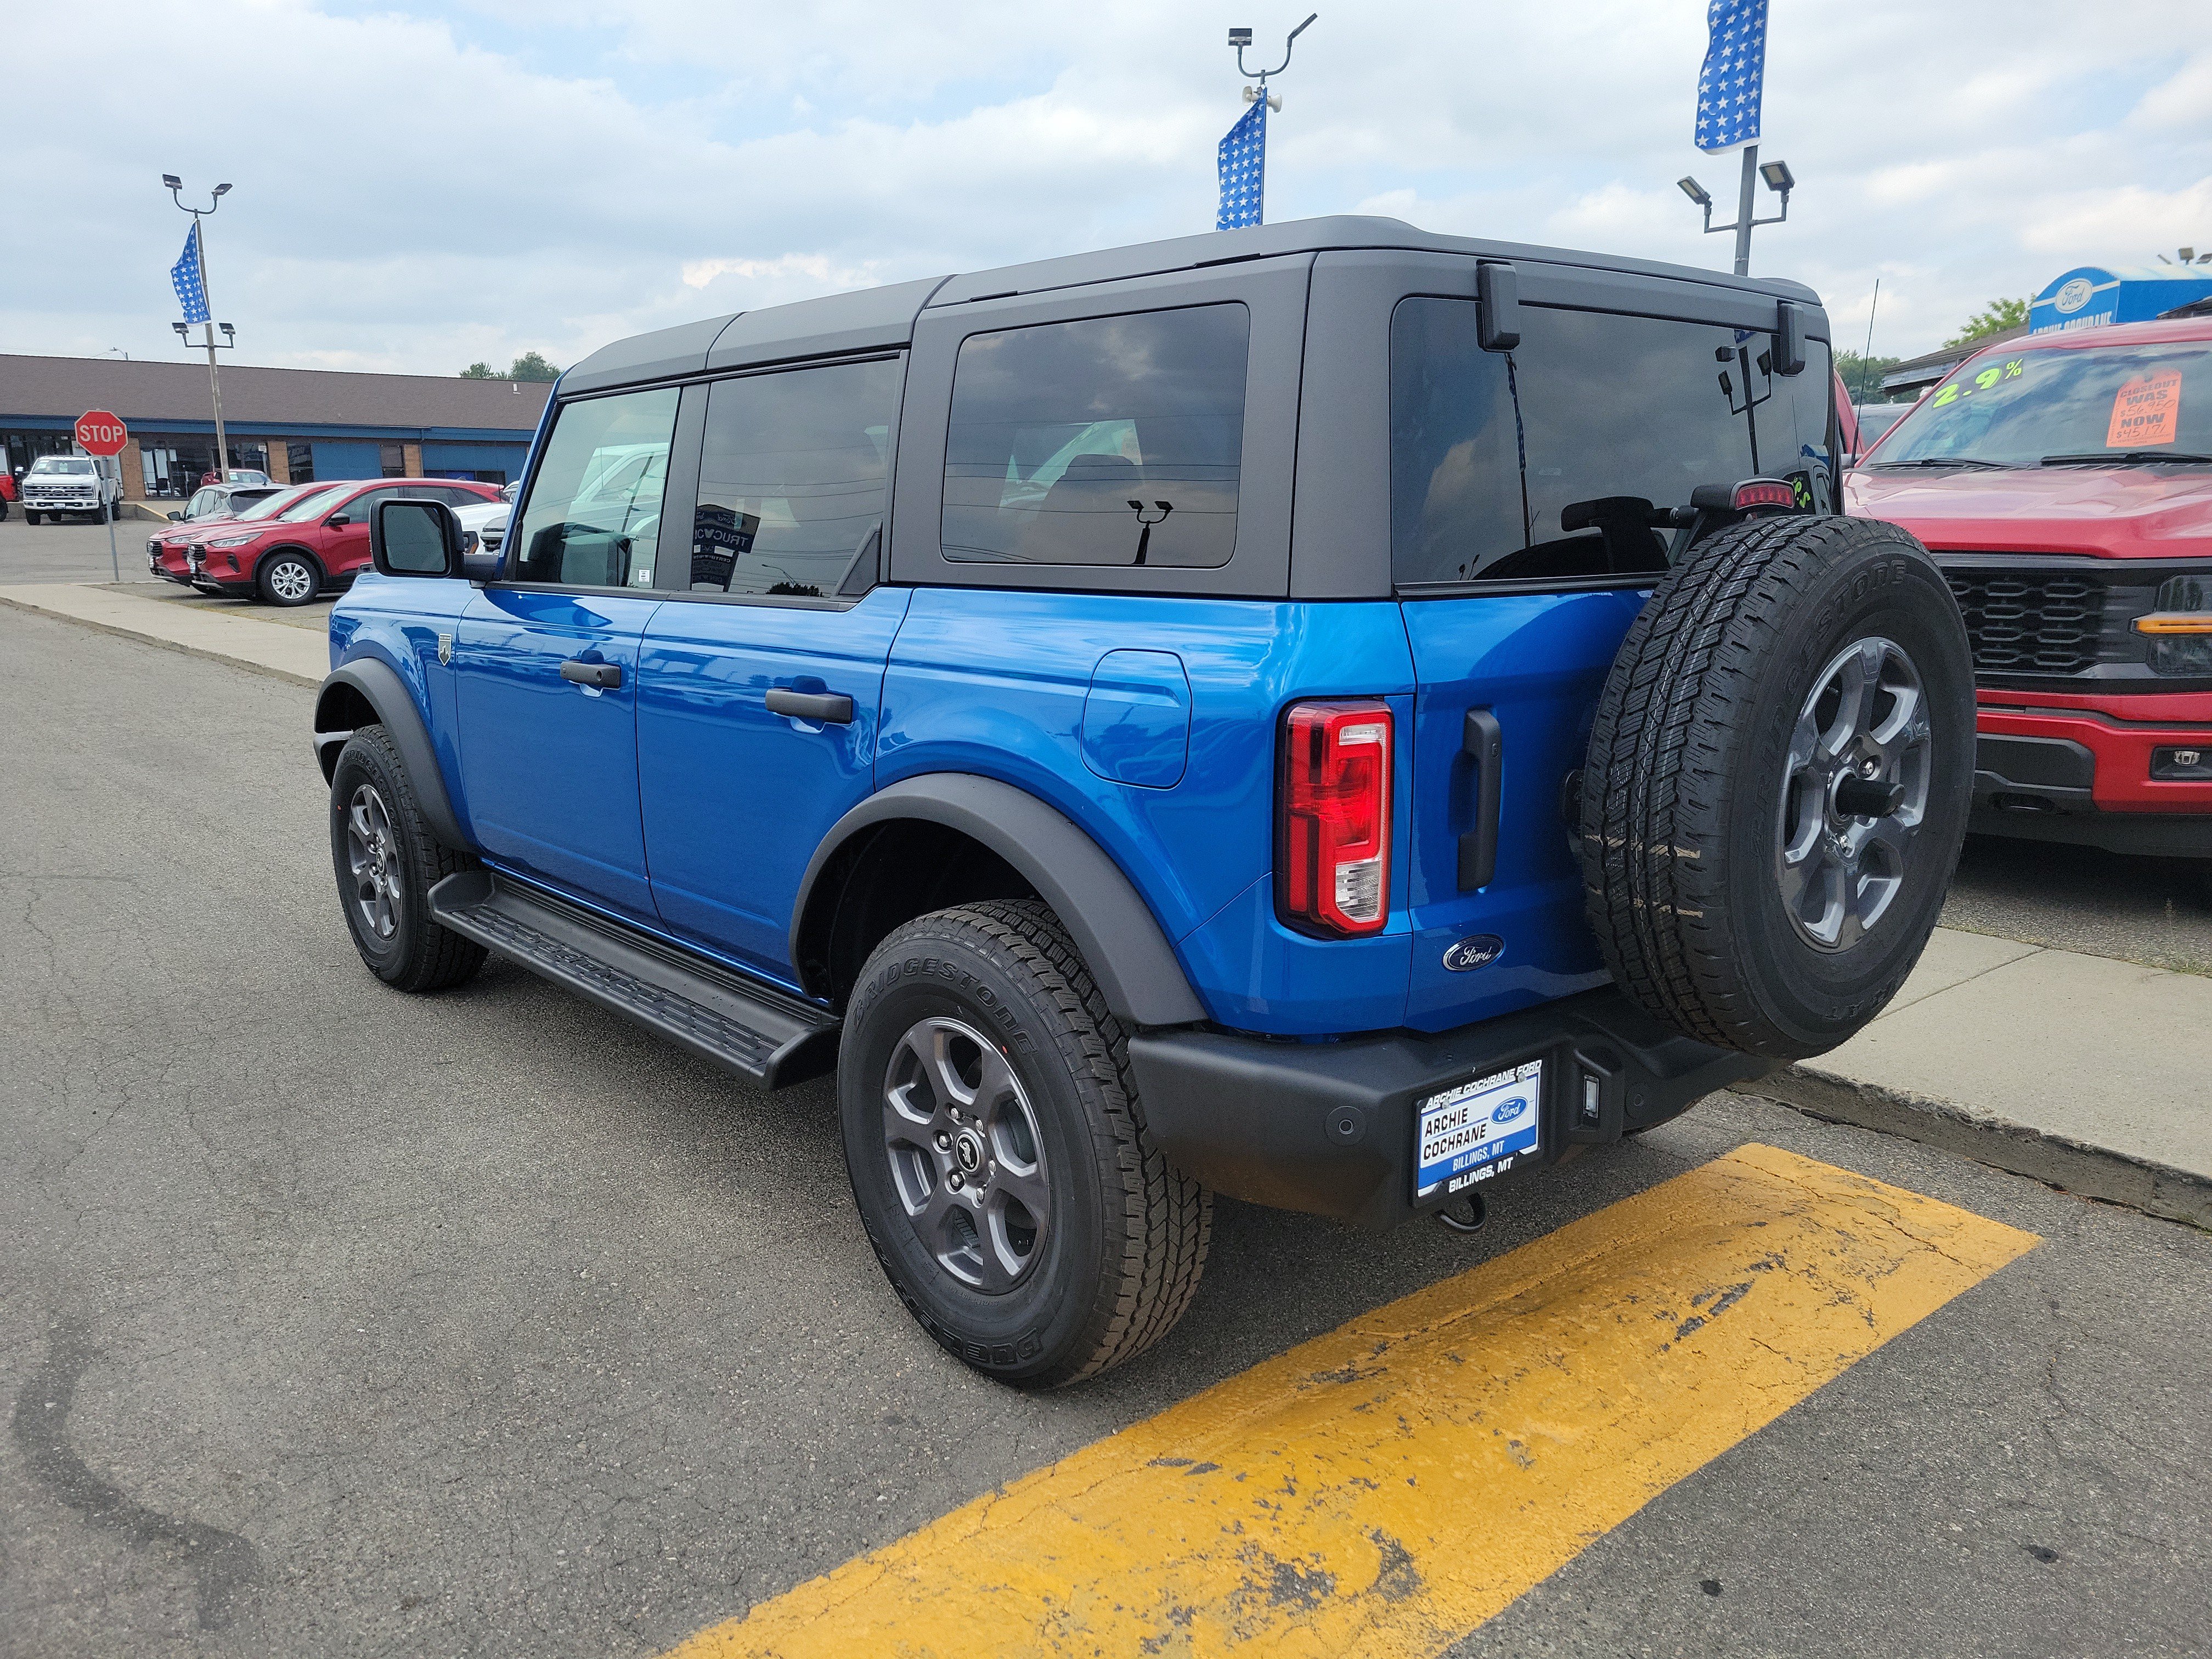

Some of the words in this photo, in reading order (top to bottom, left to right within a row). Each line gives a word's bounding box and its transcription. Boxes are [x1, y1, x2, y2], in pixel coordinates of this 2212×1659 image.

[2062, 284, 2085, 306] Ford
[1933, 358, 2023, 408] 2.9%
[2120, 379, 2178, 398] CLOSEOUT
[2126, 390, 2168, 405] WAS
[80, 425, 123, 442] STOP
[2121, 413, 2165, 428] NOW
[1459, 946, 1492, 966] Ford
[854, 954, 1038, 1054] BRIDGESTONE
[1426, 1086, 1463, 1108] ARCHIE
[1463, 1068, 1516, 1094] COCHRANE
[1516, 1060, 1542, 1076] FORD
[1425, 1107, 1468, 1137] ARCHIE
[1497, 1101, 1521, 1120] Ford
[1423, 1123, 1487, 1160] COCHRANE
[1452, 1146, 1490, 1172] BILLINGS,
[1492, 1140, 1505, 1156] MT
[1448, 1164, 1495, 1194] BILLINGS,
[1497, 1157, 1514, 1174] MT
